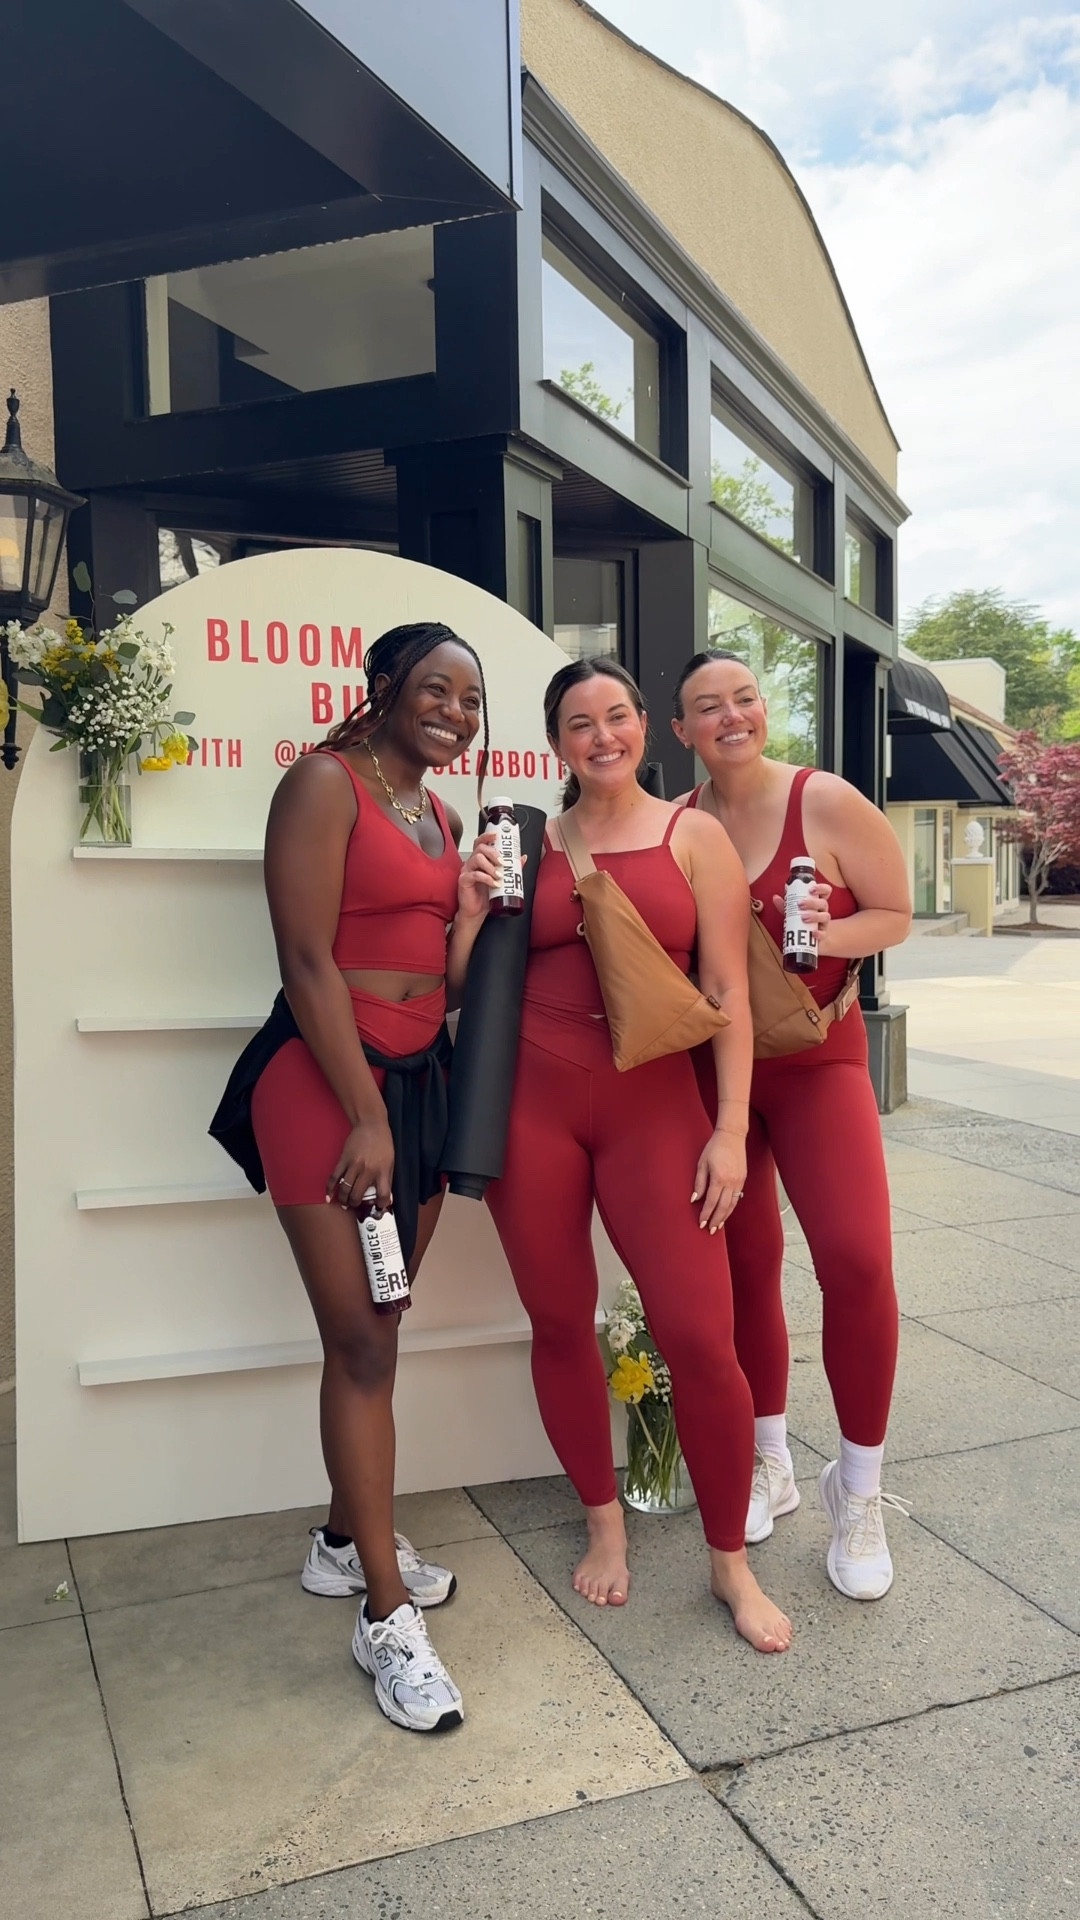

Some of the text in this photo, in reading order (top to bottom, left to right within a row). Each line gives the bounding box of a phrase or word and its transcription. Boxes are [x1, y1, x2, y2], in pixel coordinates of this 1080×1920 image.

[206, 618, 363, 669] BLOOM
[186, 737, 242, 768] ITH
[500, 834, 515, 895] CLEAN JUICE
[367, 1232, 385, 1266] JUICE
[374, 1267, 391, 1302] CLEAN
